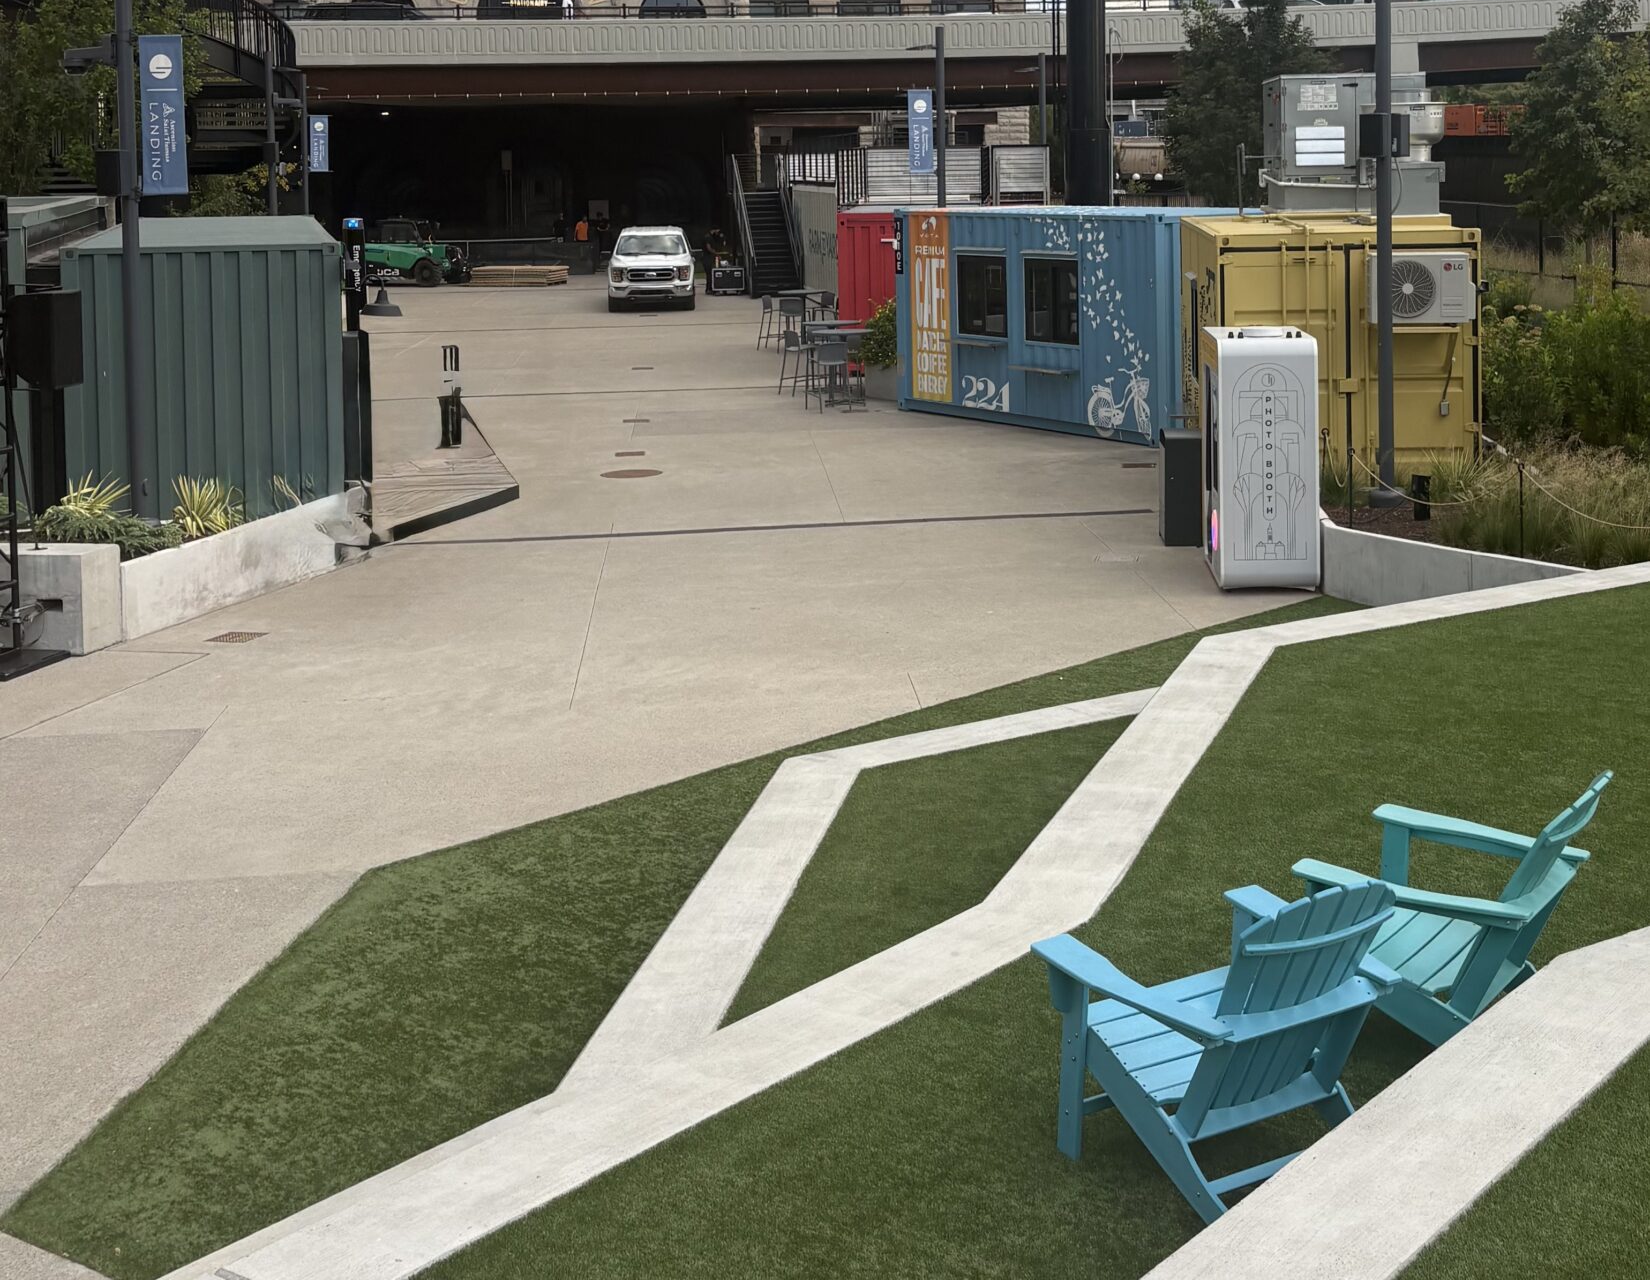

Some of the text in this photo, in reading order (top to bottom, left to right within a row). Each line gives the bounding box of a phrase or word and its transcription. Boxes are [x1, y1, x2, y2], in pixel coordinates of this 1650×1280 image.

[149, 102, 162, 181] LANDING
[913, 124, 921, 167] LANDING
[352, 244, 361, 292] Emeency
[1264, 396, 1274, 515] PHOTO BOOTH
